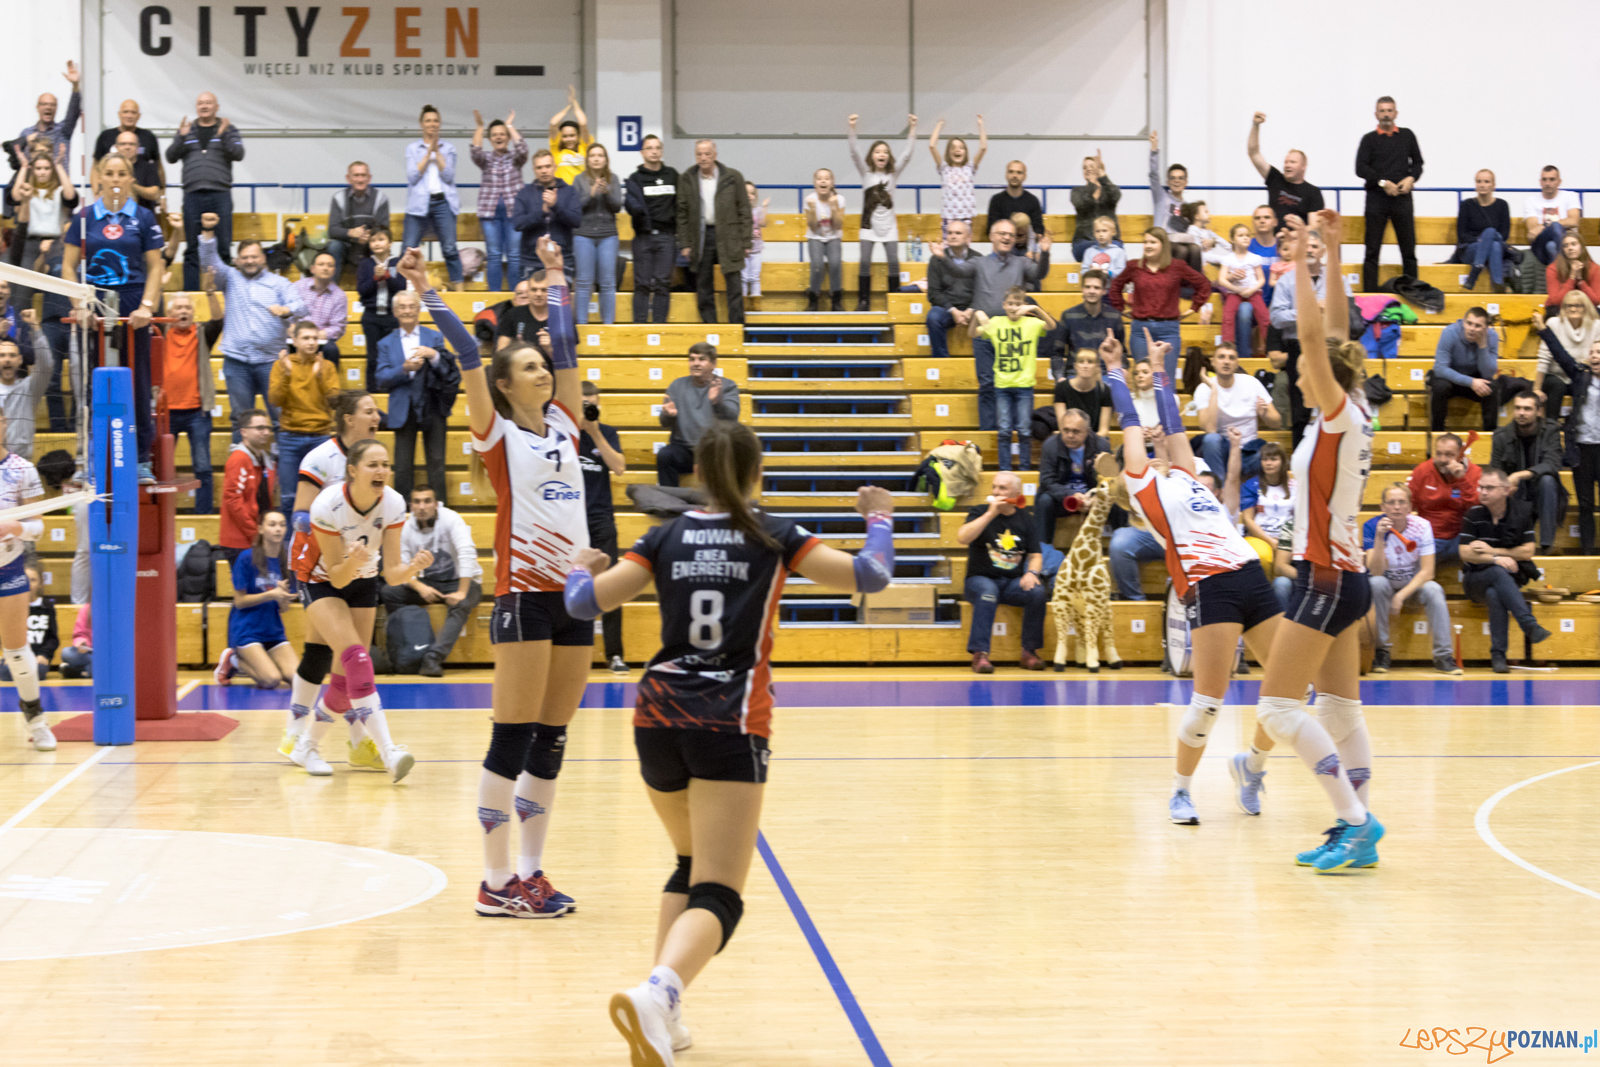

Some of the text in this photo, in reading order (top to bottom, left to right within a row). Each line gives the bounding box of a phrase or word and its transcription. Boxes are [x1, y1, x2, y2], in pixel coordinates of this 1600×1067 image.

[139, 6, 479, 57] CITYZEN
[243, 63, 300, 78] WIĘCEJ
[343, 63, 384, 75] KLUB
[392, 63, 480, 75] SPORTOWY
[621, 121, 639, 146] B
[996, 327, 1022, 342] UN
[546, 449, 561, 472] 7
[543, 489, 581, 501] Enea
[694, 549, 728, 561] ENEA
[672, 561, 749, 581] ENERGETYK
[502, 612, 512, 628] 7
[689, 589, 725, 649] 8
